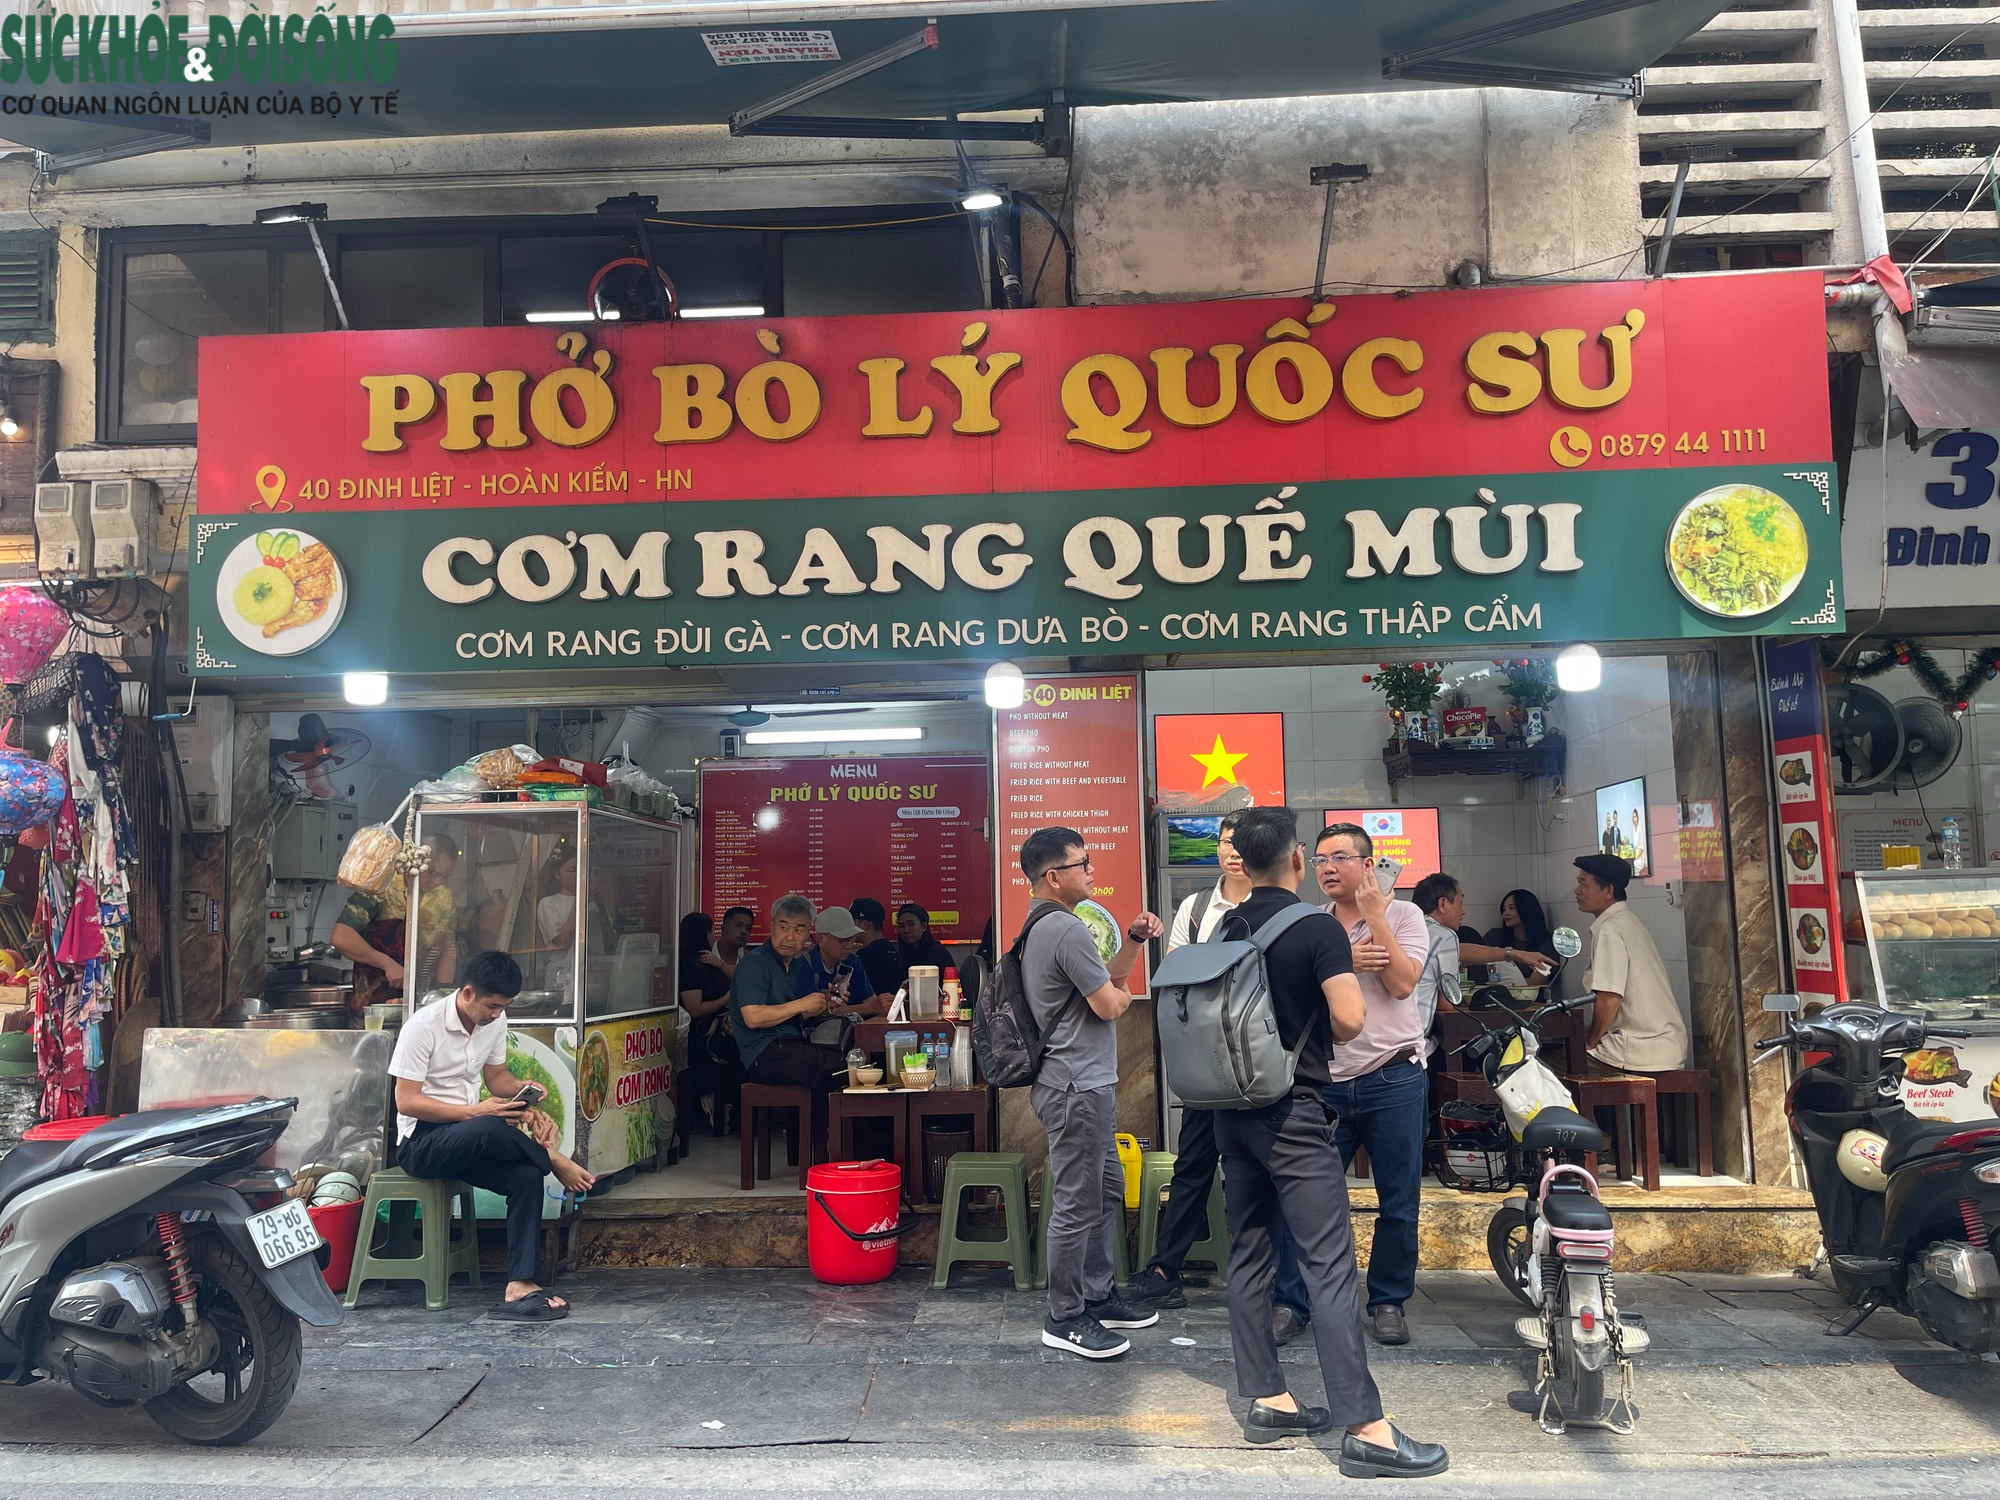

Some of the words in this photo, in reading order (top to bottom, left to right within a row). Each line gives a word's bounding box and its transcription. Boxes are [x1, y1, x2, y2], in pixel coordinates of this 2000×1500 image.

[360, 331, 618, 453] PHỞ
[652, 328, 821, 445] BÒ
[858, 321, 1022, 438] LÝ
[1060, 302, 1425, 453] QUỐC
[1465, 308, 1645, 413] SƯ
[1600, 433, 1666, 457] 0879
[1674, 431, 1709, 454] 44
[1720, 428, 1766, 452] 1111
[299, 478, 330, 500] 40
[337, 474, 402, 498] ĐINH
[410, 471, 455, 503] LIỆT
[480, 466, 561, 496] HOÀN
[567, 461, 629, 493] KIẾM
[655, 468, 693, 490] HN
[421, 530, 673, 604] CƠM
[693, 522, 1034, 599] RANG
[1062, 485, 1313, 600] QUẾ
[1344, 487, 1584, 579] MÙI
[455, 630, 534, 658] CƠM
[546, 627, 642, 656] RANG
[654, 619, 711, 655] ĐÙI
[724, 618, 773, 652] GÀ
[801, 621, 879, 651] CƠM
[892, 618, 985, 648] RANG
[997, 615, 1068, 646] DƯA
[1081, 608, 1130, 643] BÒ
[1160, 610, 1239, 641] CƠM
[1251, 608, 1348, 638] RANG
[1358, 600, 1452, 640] THẬP
[1463, 594, 1543, 632] CẨM
[1035, 688, 1054, 701] 40
[1059, 687, 1097, 700] ĐINH
[1102, 683, 1132, 702] LIỆT
[1024, 712, 1050, 720] WITHOUT
[1026, 729, 1039, 737] PHO
[830, 764, 878, 779] MENU
[1010, 762, 1028, 770] FRIED
[1044, 761, 1072, 769] WITHOUT
[1074, 760, 1090, 768] MEAT
[1010, 778, 1028, 786] FRIED
[1030, 778, 1043, 786] RICE
[1062, 777, 1077, 785] BEEF
[1078, 777, 1091, 785] AND
[1094, 776, 1127, 784] VEGETABLE
[770, 782, 812, 802] PHỞ
[818, 784, 841, 801] LÝ
[848, 781, 902, 802] QUỐC
[908, 783, 938, 800] SƯ
[1030, 811, 1043, 819] RICE
[1062, 810, 1089, 818] CHICKEN
[1893, 818, 1923, 826] MENU
[1084, 826, 1111, 834] WITHOUT
[1112, 826, 1129, 834] MEAT
[1012, 844, 1021, 852] FRI
[1084, 843, 1099, 851] WITH
[1101, 843, 1116, 851] BEEF
[1382, 838, 1412, 846] THỐNG
[1383, 848, 1407, 856] QUỐC
[1012, 878, 1024, 886] PHO
[625, 1020, 647, 1063] PHỞ
[650, 1020, 665, 1057] BÒ
[616, 1071, 642, 1108] CƠM
[643, 1064, 671, 1099] RANG
[1906, 1088, 1929, 1099] Beef
[1929, 1088, 1955, 1099] Steak
[1556, 1128, 1578, 1143] 707
[263, 1225, 316, 1263] 066.95
